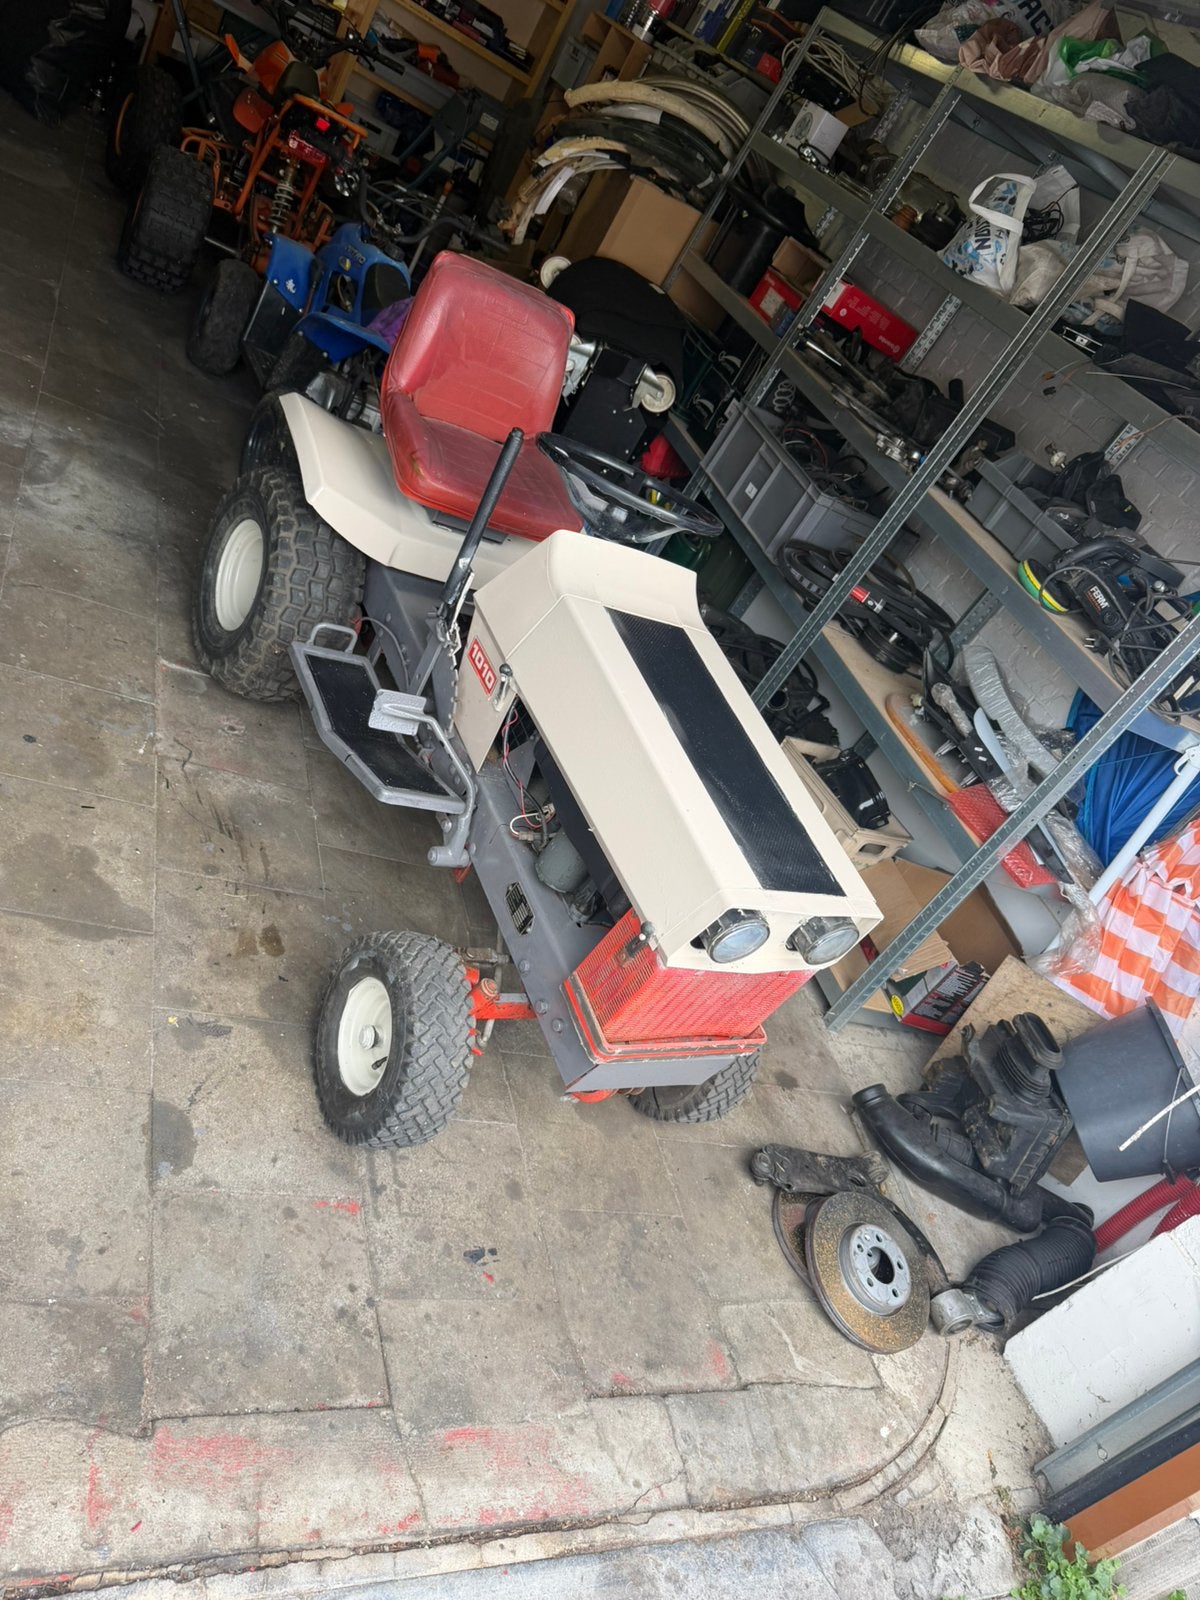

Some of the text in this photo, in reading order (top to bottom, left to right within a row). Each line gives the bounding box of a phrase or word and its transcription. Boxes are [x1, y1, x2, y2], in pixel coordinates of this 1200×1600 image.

[1018, 0, 1054, 36] AC
[1090, 586, 1108, 609] FERM
[472, 644, 495, 689] 1010
